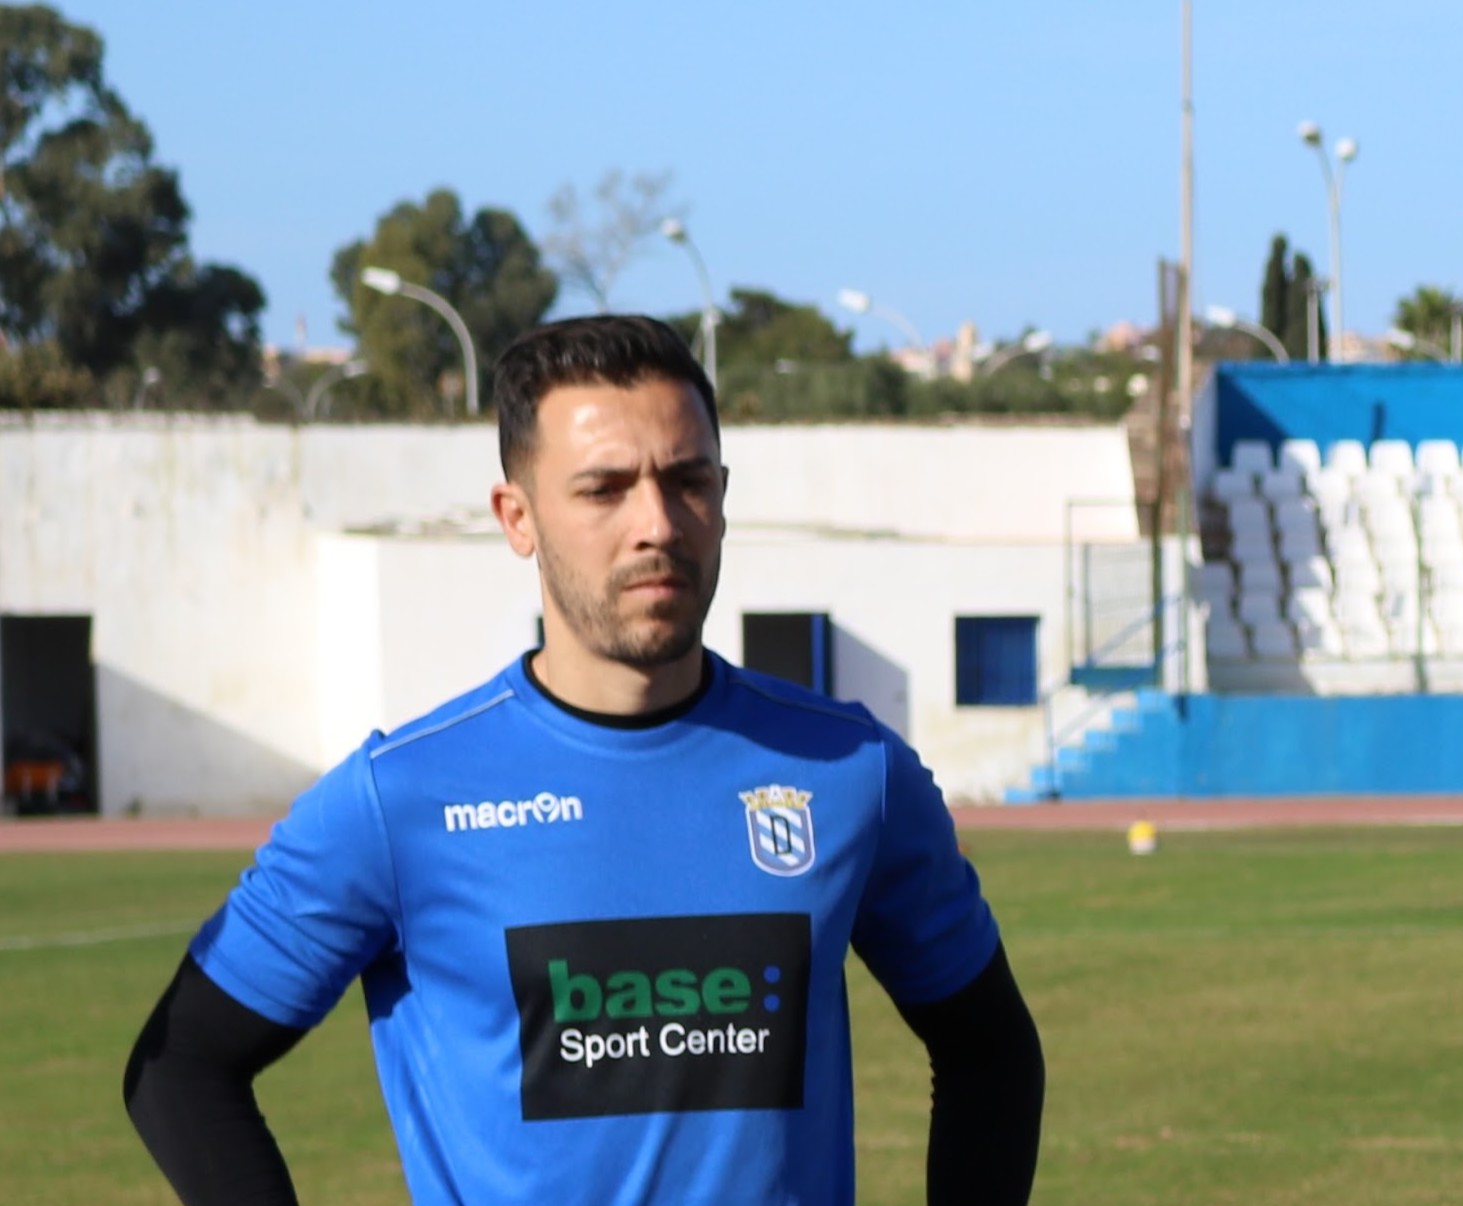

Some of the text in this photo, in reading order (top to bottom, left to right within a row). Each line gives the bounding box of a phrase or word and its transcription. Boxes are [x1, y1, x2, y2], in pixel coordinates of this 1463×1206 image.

[444, 791, 583, 832] macron
[560, 1022, 770, 1068] Sport Center
